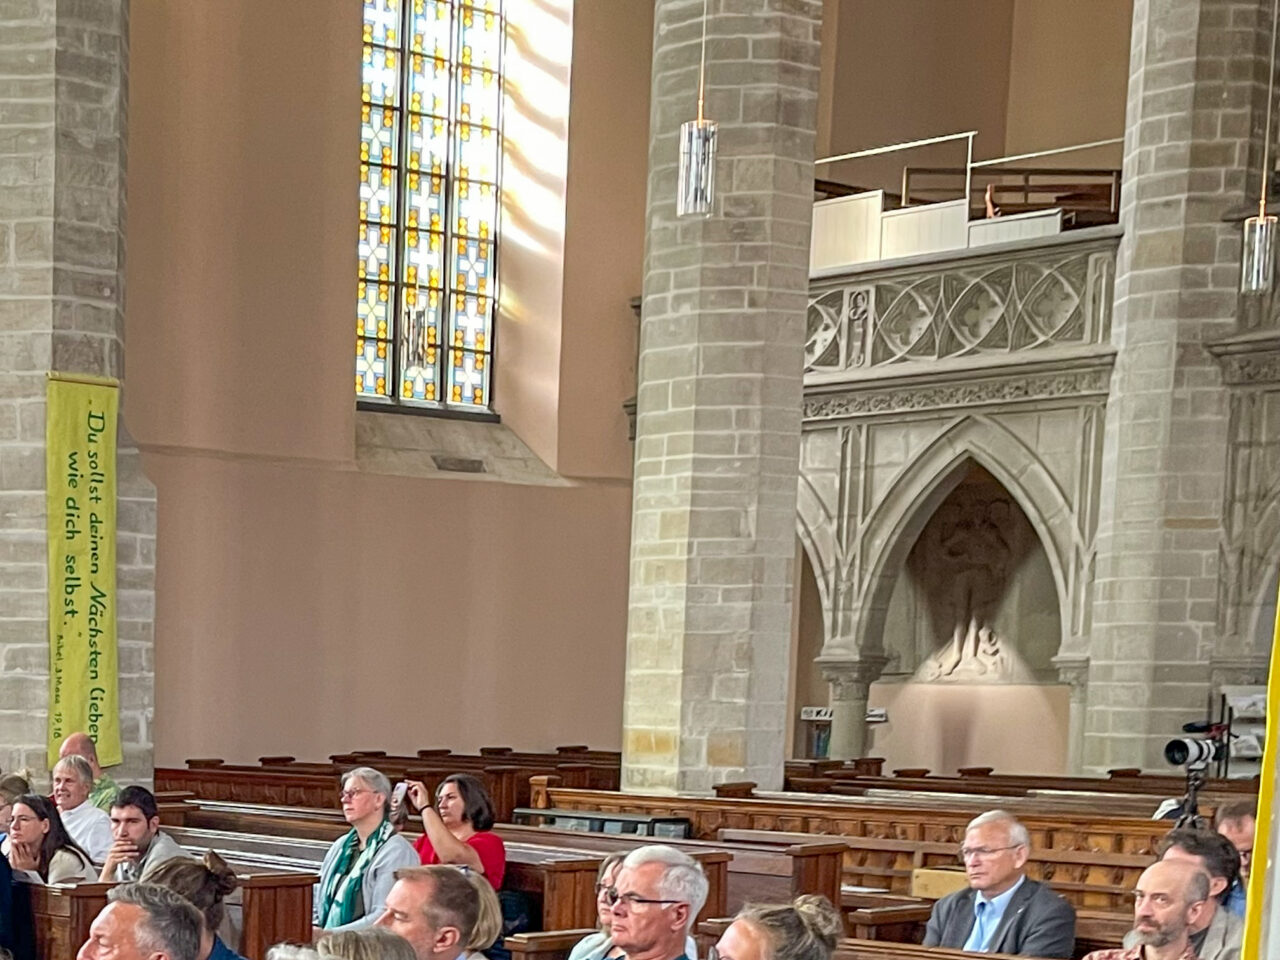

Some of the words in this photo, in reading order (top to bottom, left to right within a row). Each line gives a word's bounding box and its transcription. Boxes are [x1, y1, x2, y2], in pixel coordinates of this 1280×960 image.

[67, 451, 84, 489] wie
[87, 450, 105, 504] sollst
[65, 496, 82, 541] dich
[89, 512, 104, 574] deinen
[88, 581, 107, 680] Nächsten
